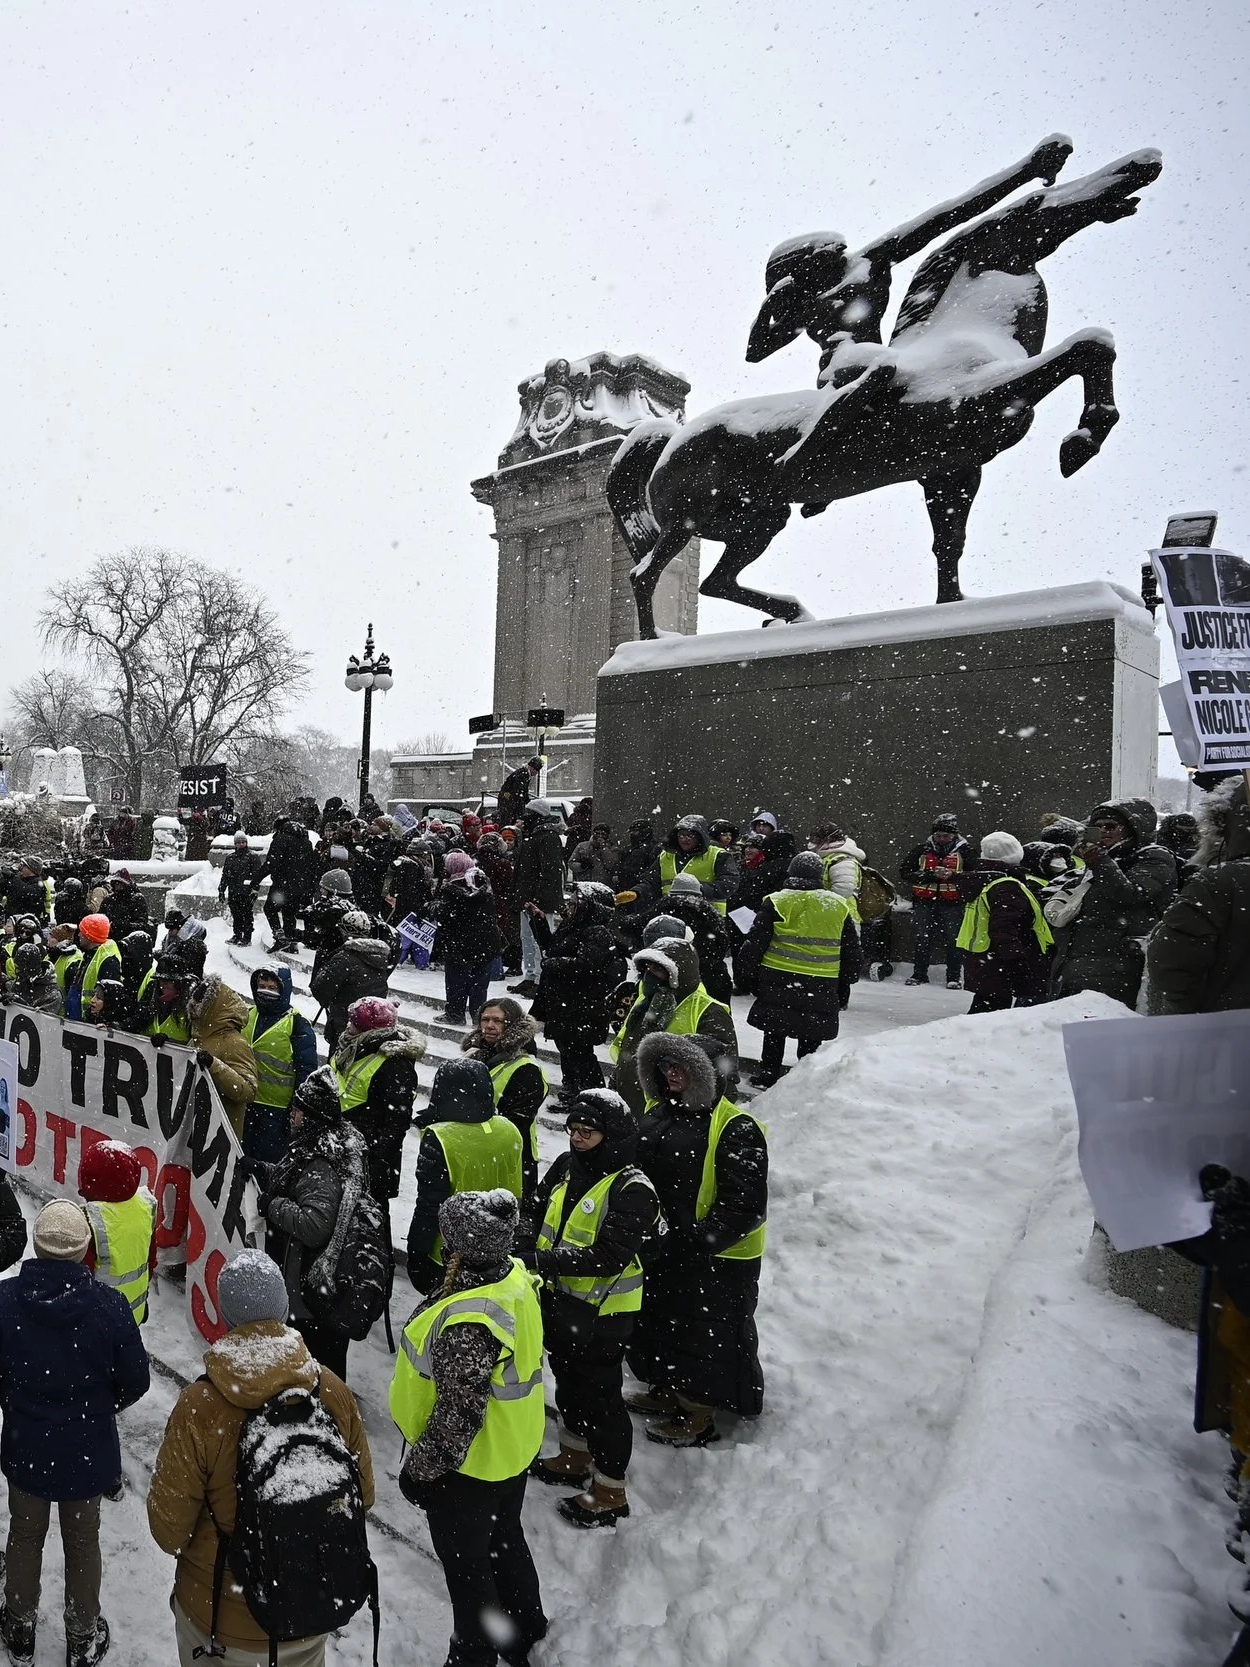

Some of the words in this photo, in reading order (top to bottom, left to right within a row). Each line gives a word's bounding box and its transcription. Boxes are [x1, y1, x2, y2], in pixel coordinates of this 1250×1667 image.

[1181, 611, 1240, 650] JUSTICE
[1238, 612, 1250, 649] FO
[1194, 699, 1247, 735] NICOLE
